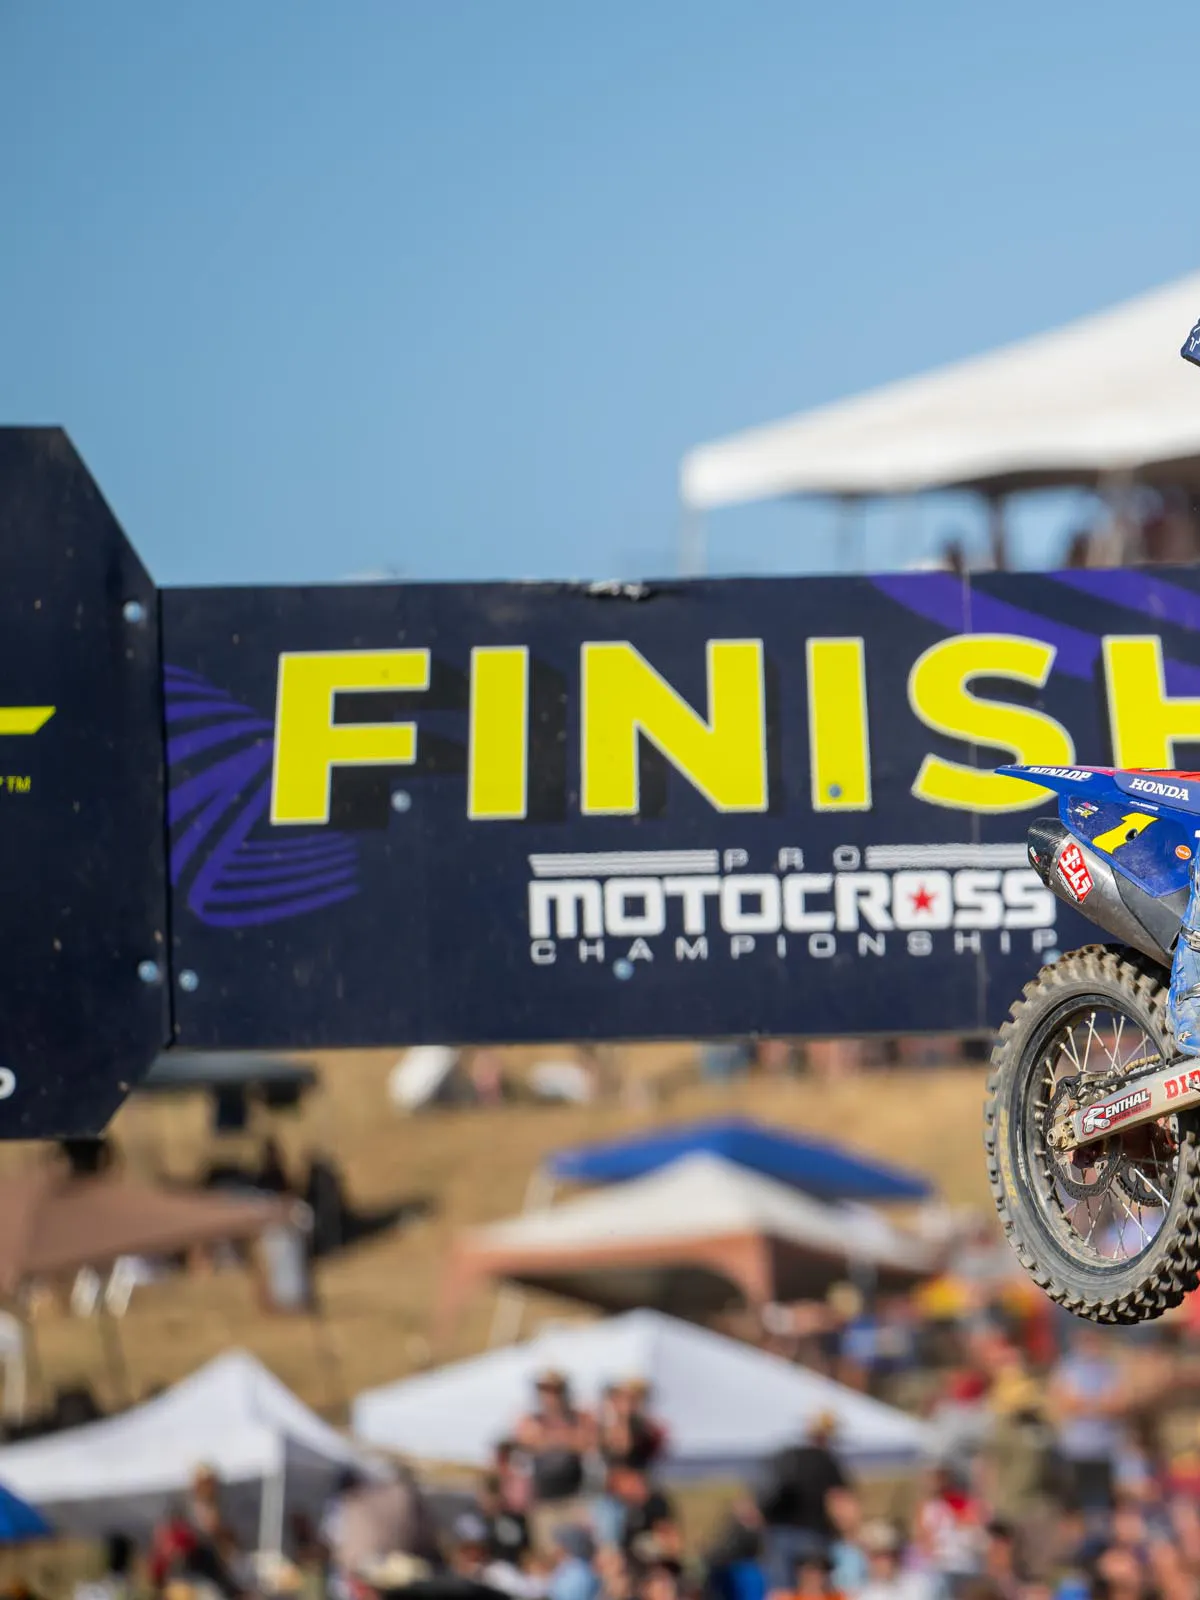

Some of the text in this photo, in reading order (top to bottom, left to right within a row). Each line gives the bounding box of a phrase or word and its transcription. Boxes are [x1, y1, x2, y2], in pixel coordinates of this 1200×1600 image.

[1027, 766, 1093, 782] DUNLOP
[1128, 778, 1190, 801] HONDA
[1091, 812, 1159, 854] 1
[724, 845, 862, 872] PRO
[527, 868, 1057, 940] MOTOCROSS
[529, 928, 1059, 966] CHAMPIONSHIP
